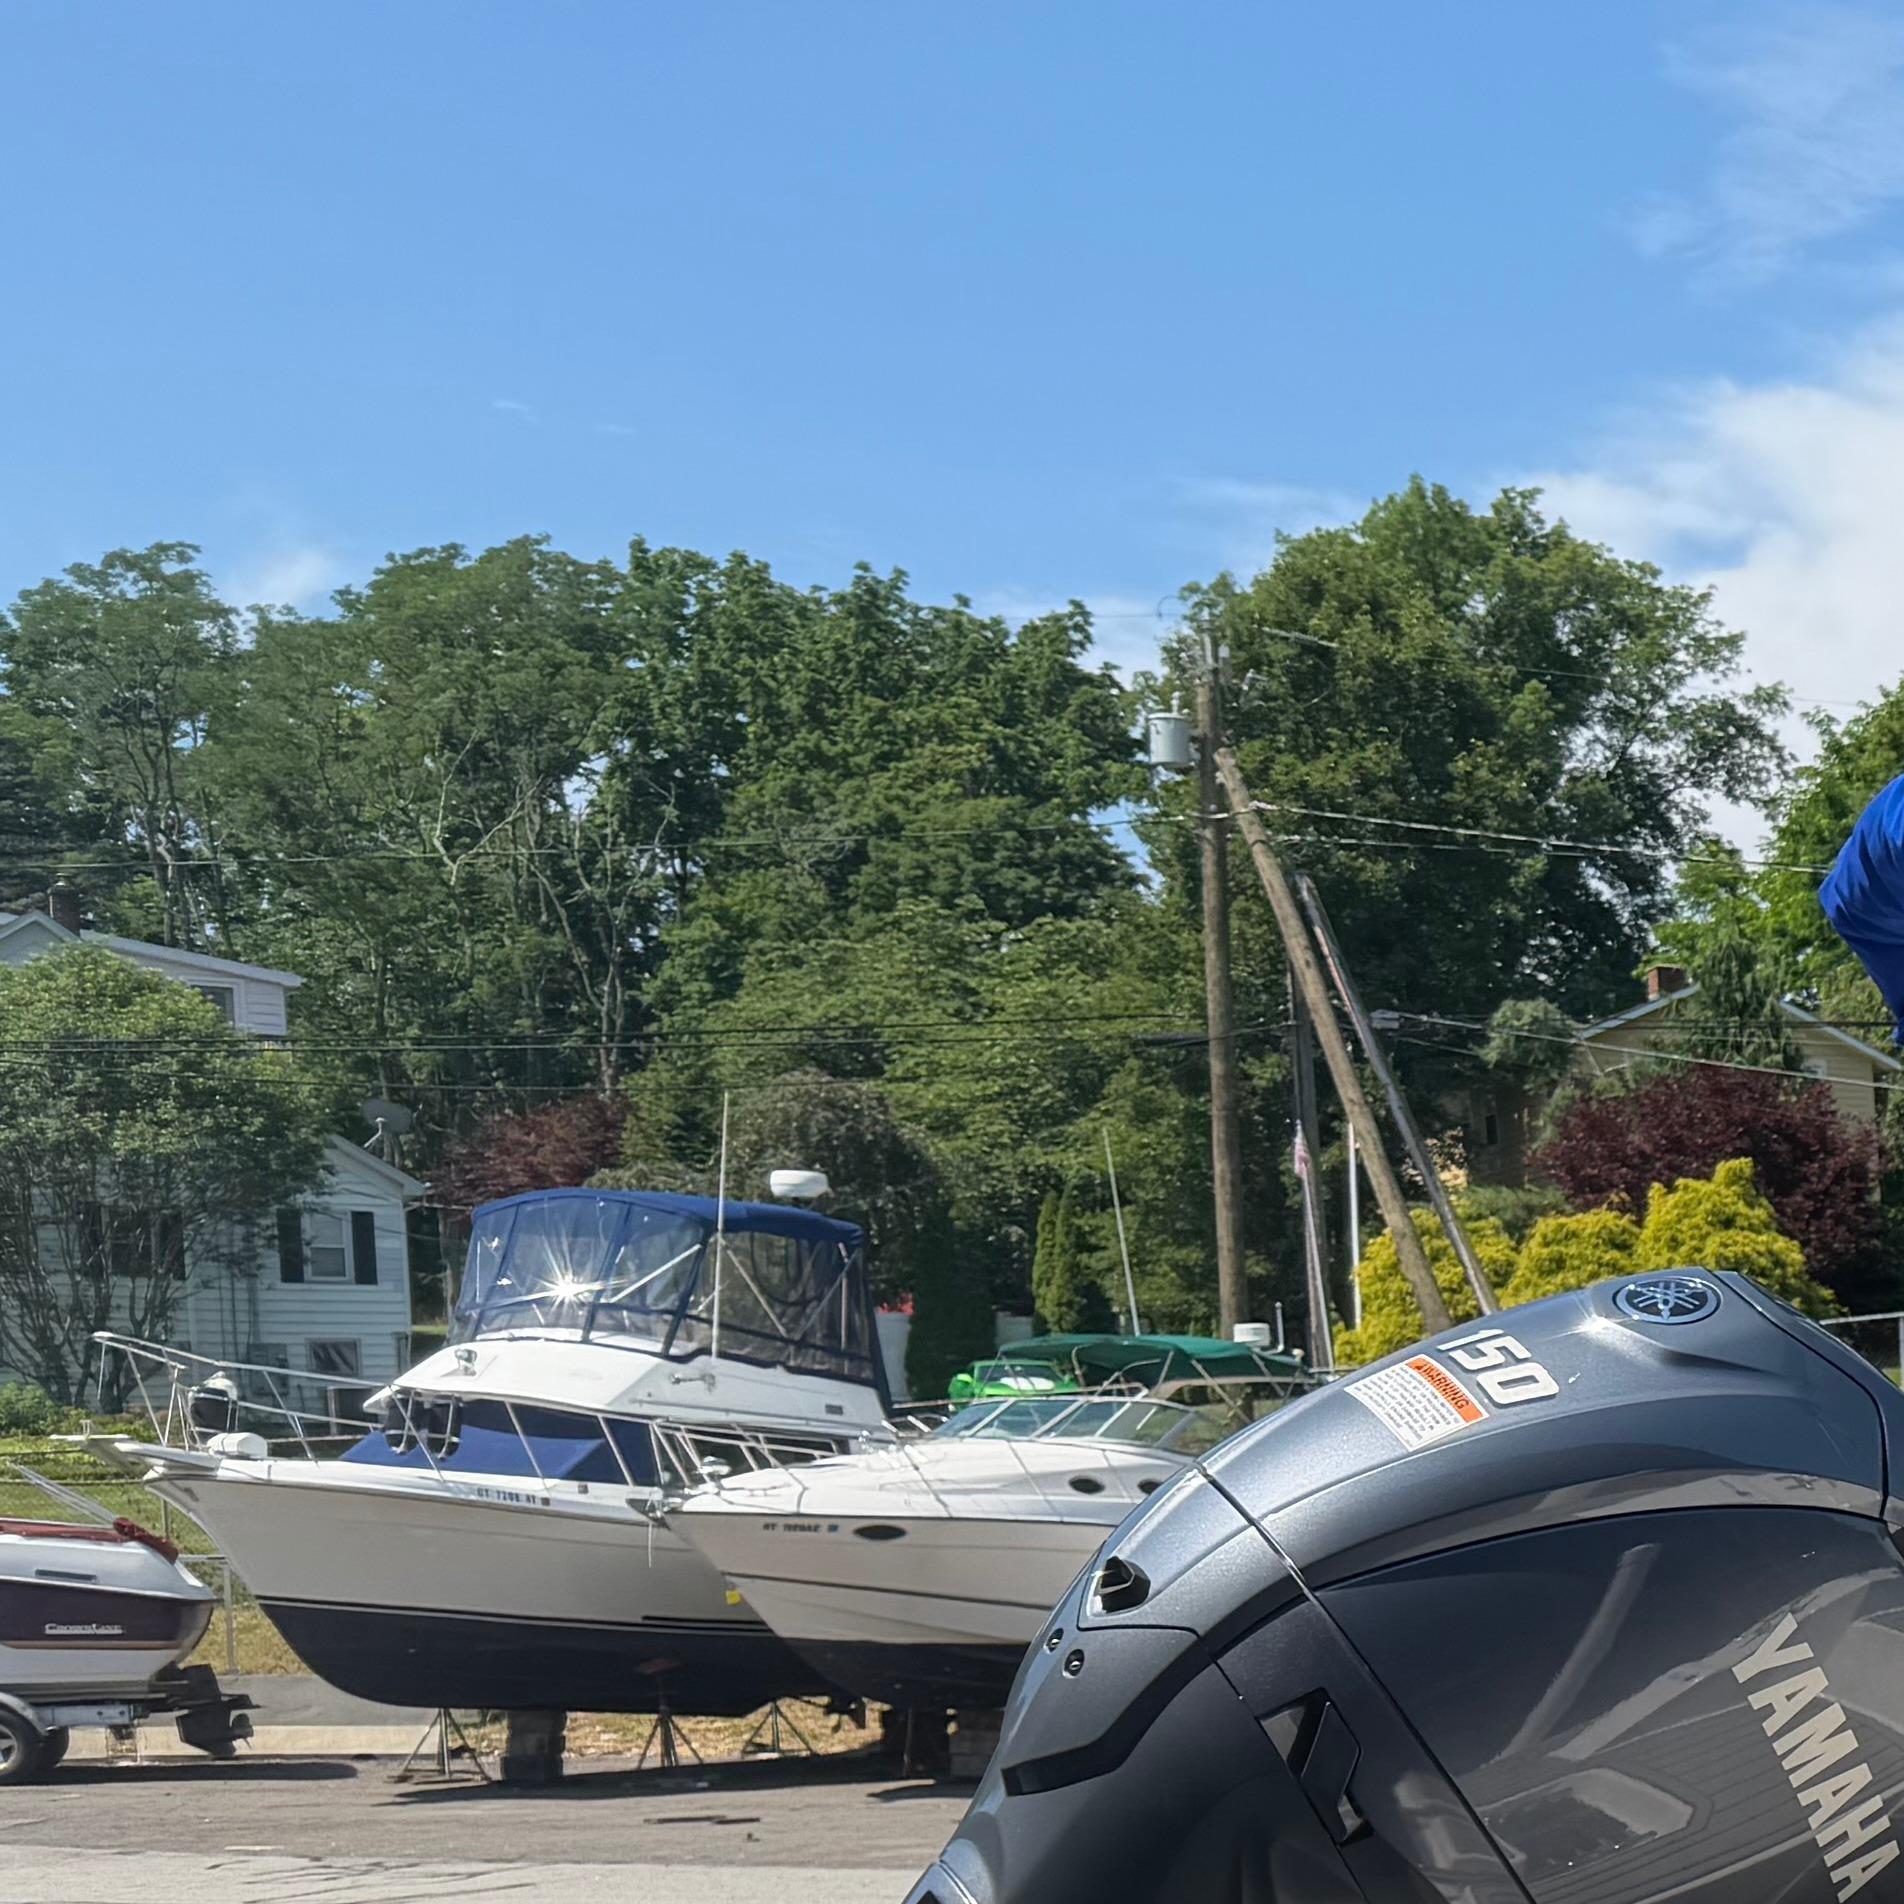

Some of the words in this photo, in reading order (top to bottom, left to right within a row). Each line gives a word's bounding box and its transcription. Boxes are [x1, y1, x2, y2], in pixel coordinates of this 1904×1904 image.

[1420, 1362, 1471, 1410] WARNING
[1436, 1328, 1560, 1405] 150
[1731, 1612, 1901, 1904] YAMAHA
